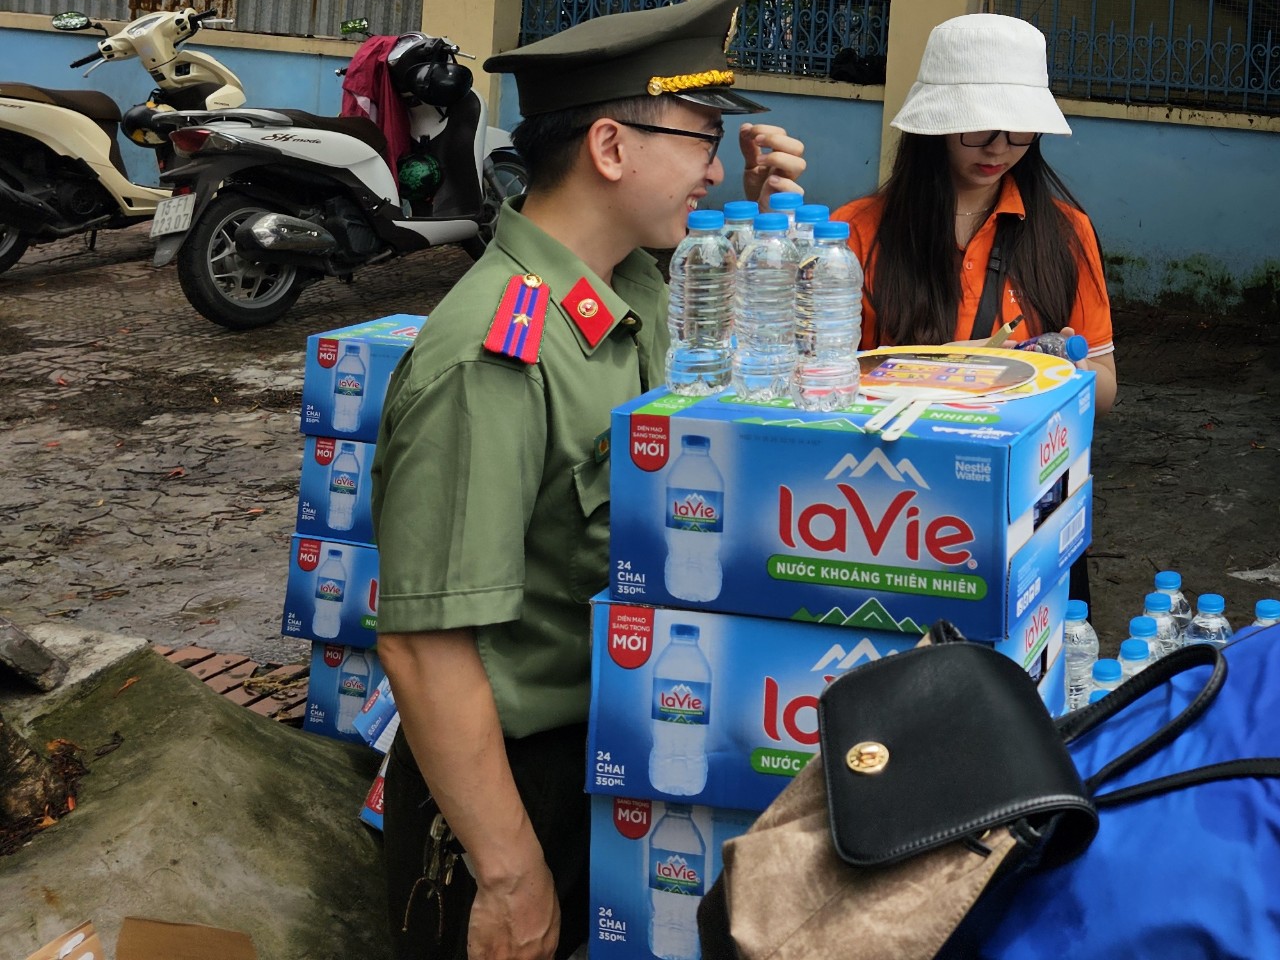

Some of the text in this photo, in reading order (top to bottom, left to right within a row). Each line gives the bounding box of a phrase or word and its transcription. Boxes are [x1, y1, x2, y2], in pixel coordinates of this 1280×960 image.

[339, 378, 360, 389] laVie
[634, 440, 664, 456] MỚI
[1040, 424, 1068, 468] laVie
[955, 460, 992, 474] Nestlé
[955, 471, 992, 482] Waters
[674, 501, 715, 518] laVie
[778, 483, 975, 567] laVie
[617, 560, 631, 570] 24
[617, 571, 646, 583] CHAI
[776, 561, 977, 594] NƯỚC KHOÁNG THIÊN NHIÊN
[617, 585, 646, 594] 350ML
[612, 632, 647, 651] MỚI
[660, 692, 702, 710] laVie
[596, 751, 611, 761] 24
[761, 755, 801, 771] NƯỚC
[596, 762, 625, 775] CHAI
[596, 777, 625, 786] 350ML
[617, 807, 647, 824] MỚI
[657, 862, 697, 881] laVie
[599, 907, 612, 917] 24
[599, 918, 626, 930] CHAI
